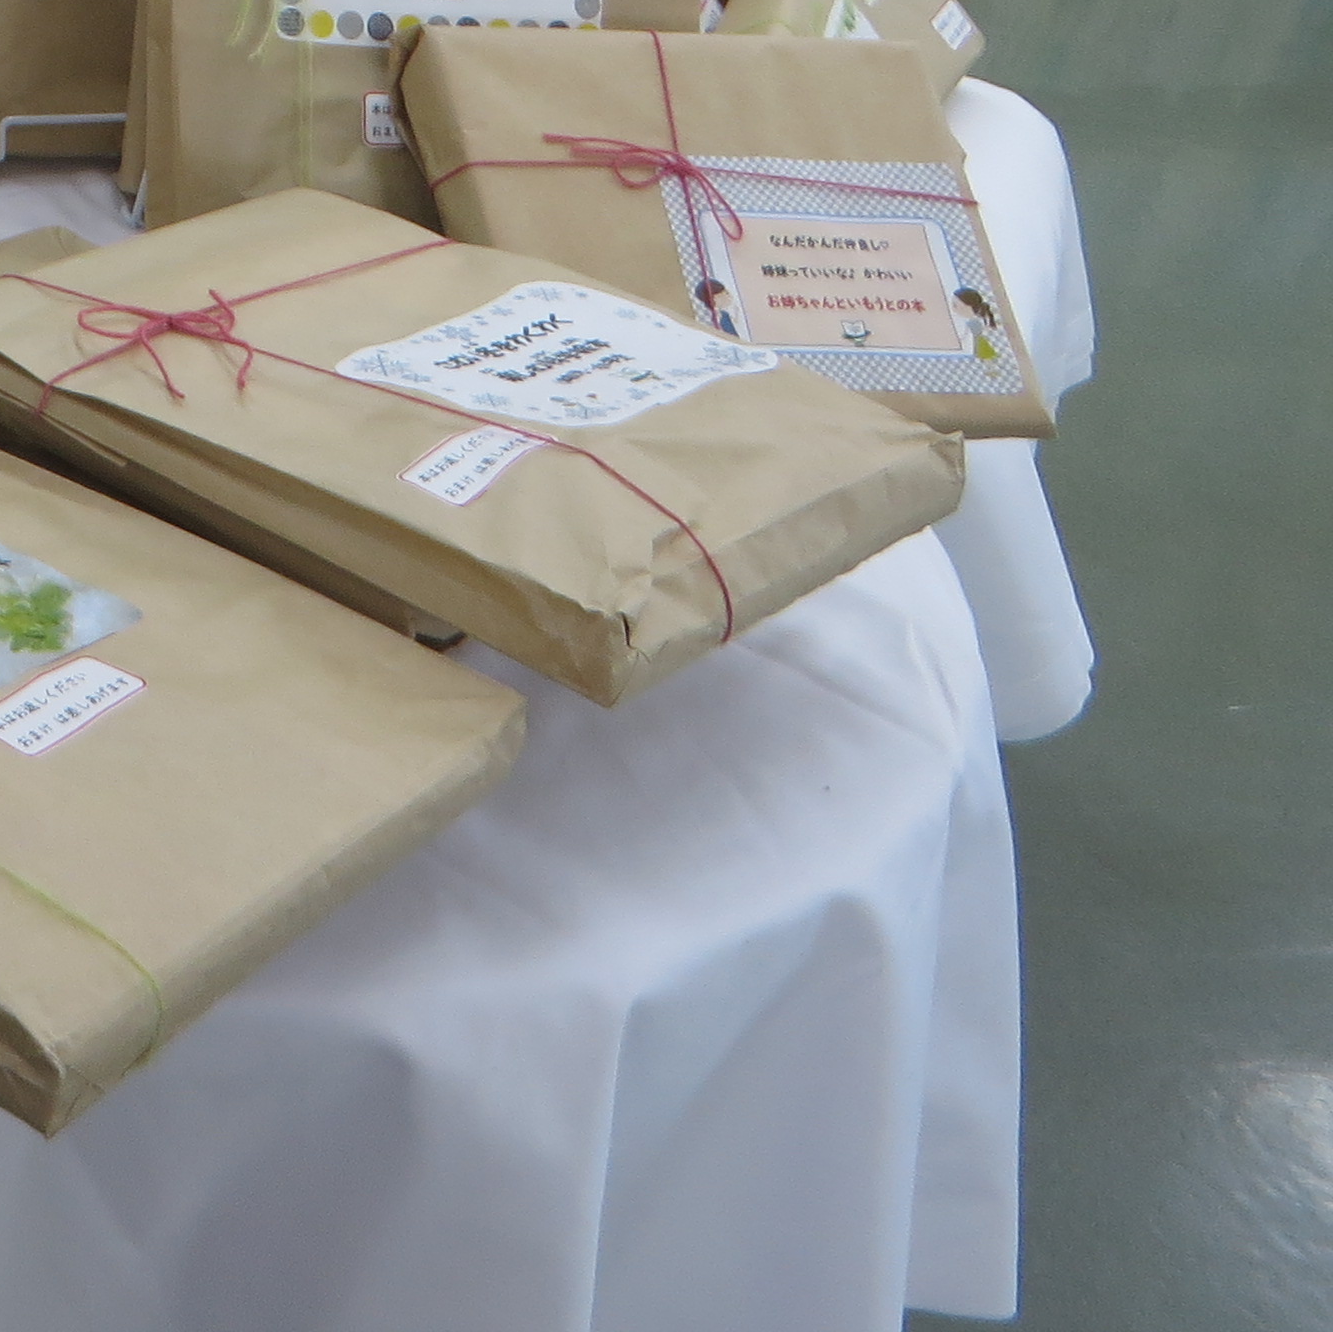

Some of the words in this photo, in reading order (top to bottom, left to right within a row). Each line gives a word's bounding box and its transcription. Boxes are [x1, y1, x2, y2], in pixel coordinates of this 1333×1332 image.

[766, 293, 926, 314] お姉ちゃんといもうとの本
[16, 723, 54, 749] おまけ
